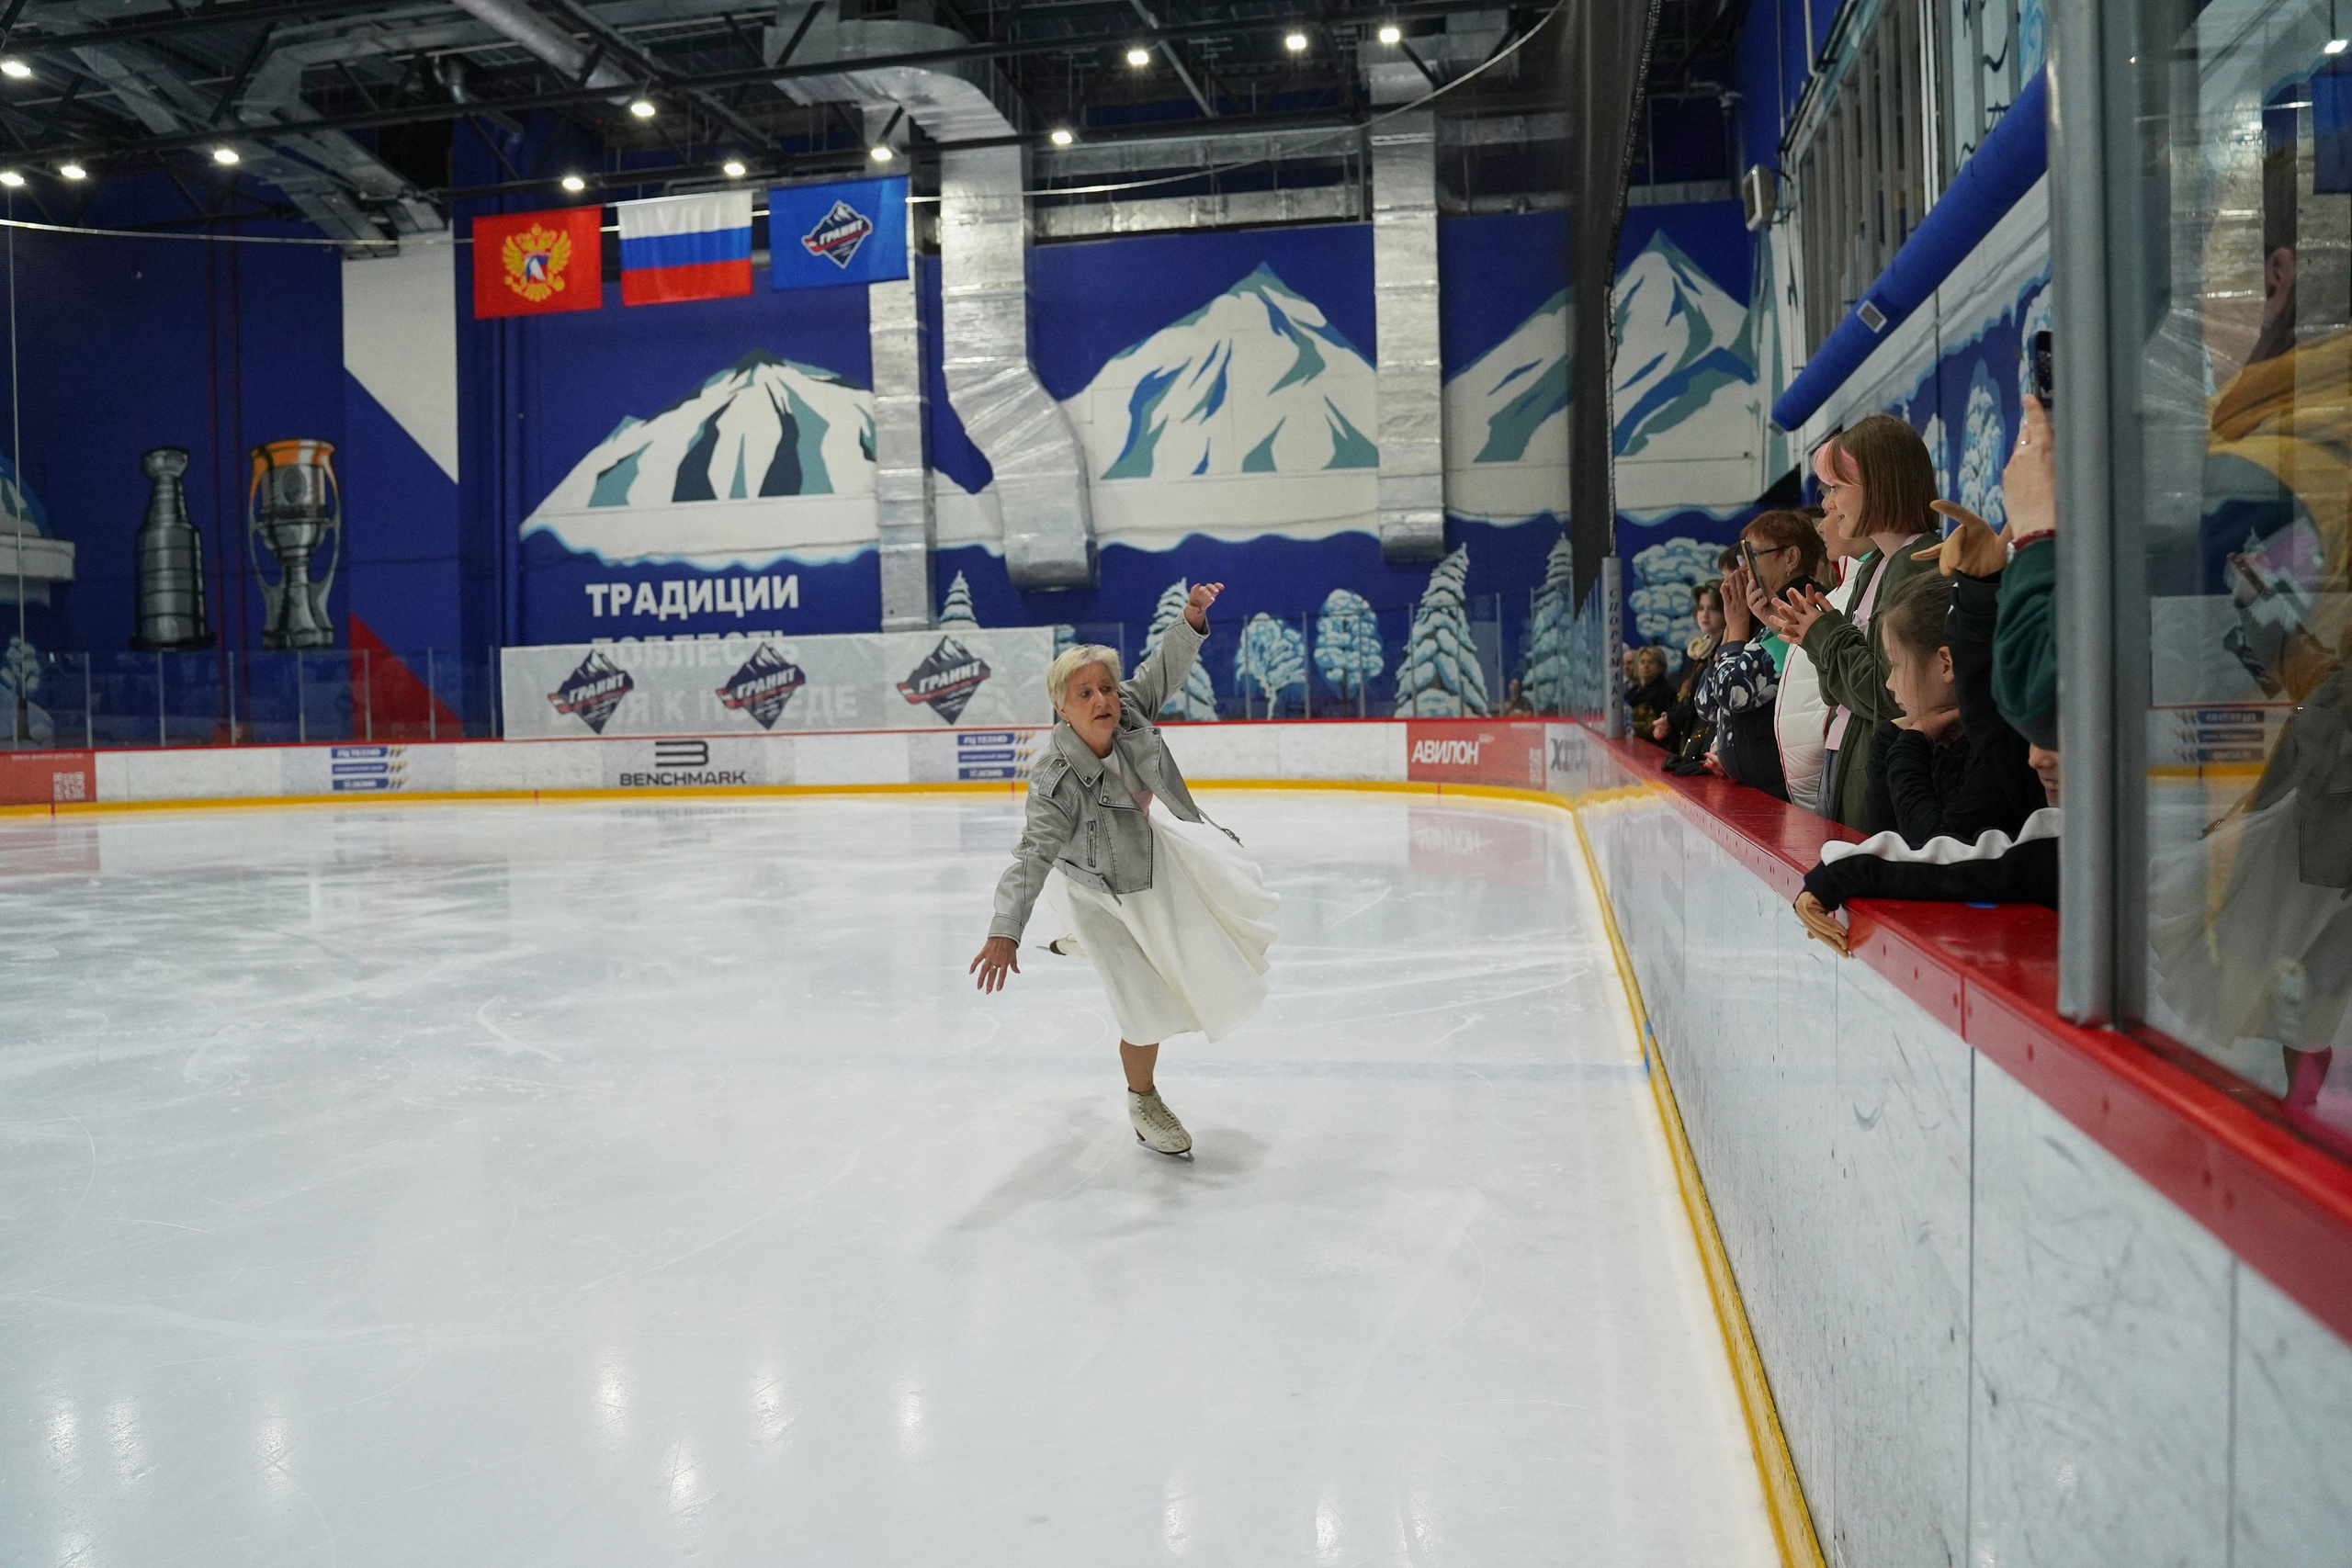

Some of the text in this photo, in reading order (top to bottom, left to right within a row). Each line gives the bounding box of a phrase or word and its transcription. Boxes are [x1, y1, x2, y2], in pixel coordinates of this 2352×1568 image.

[819, 219, 863, 246] ГРАНИТ
[584, 574, 799, 622] ТРАДИЦИИ
[568, 671, 626, 705] ГРАНИТ
[736, 667, 797, 699] ГРАНИТ
[917, 660, 983, 695] ГРАНИТ
[1410, 739, 1480, 766] АВИЛОН
[619, 770, 747, 787] BENCHMARK
